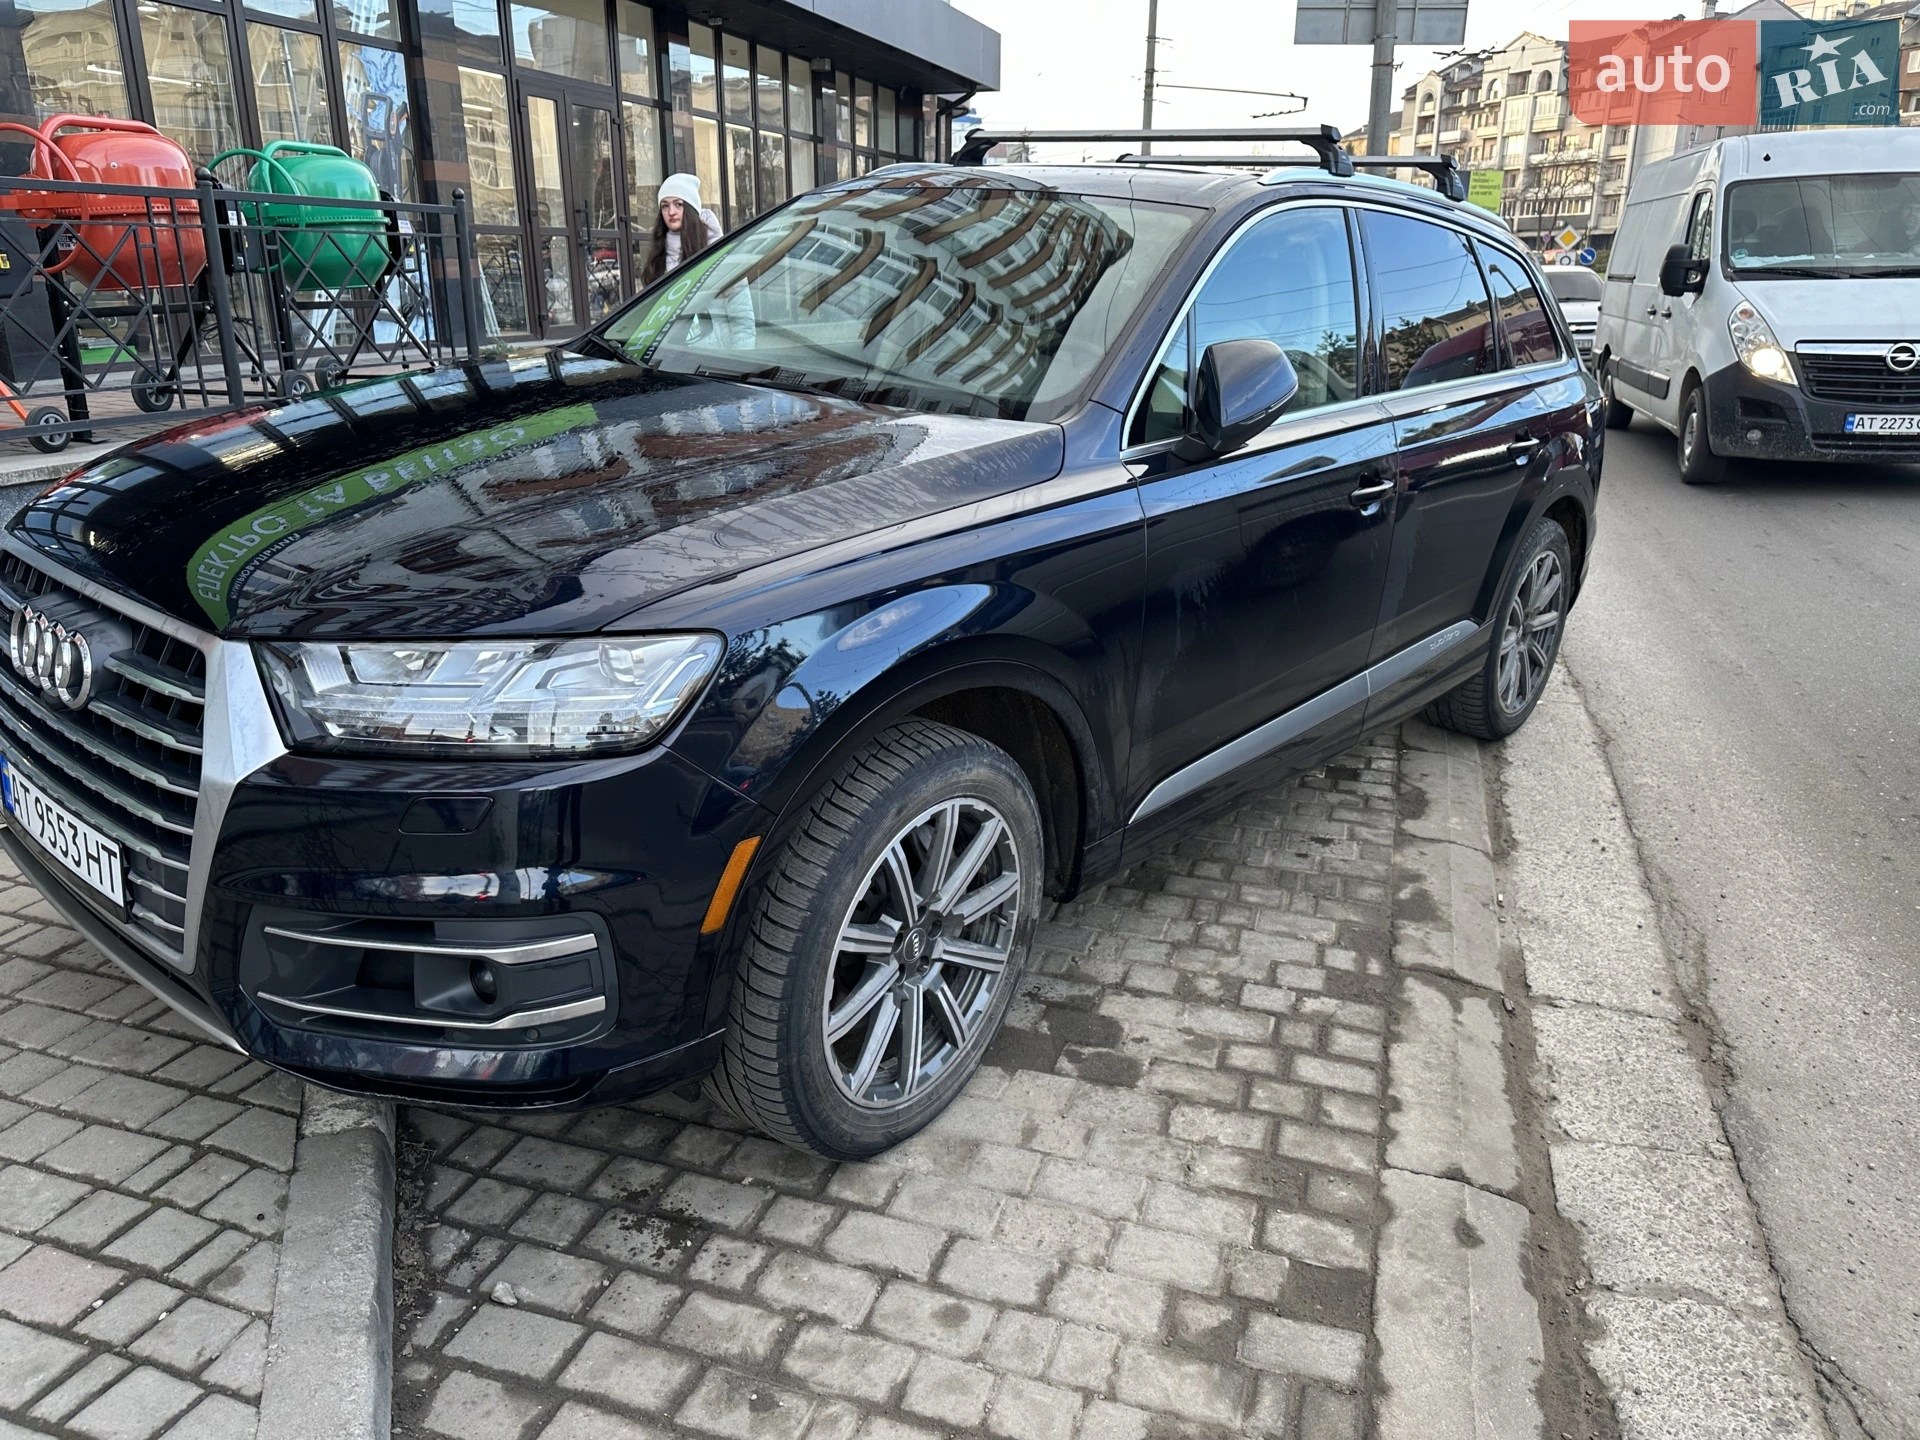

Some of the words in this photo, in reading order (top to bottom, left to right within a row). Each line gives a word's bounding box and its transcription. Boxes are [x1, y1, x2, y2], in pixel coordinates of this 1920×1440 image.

[1855, 417, 1877, 429] AT
[1879, 417, 1915, 430] 2273
[11, 773, 31, 828] AT
[34, 795, 82, 868] 9553
[83, 832, 118, 894] HT
